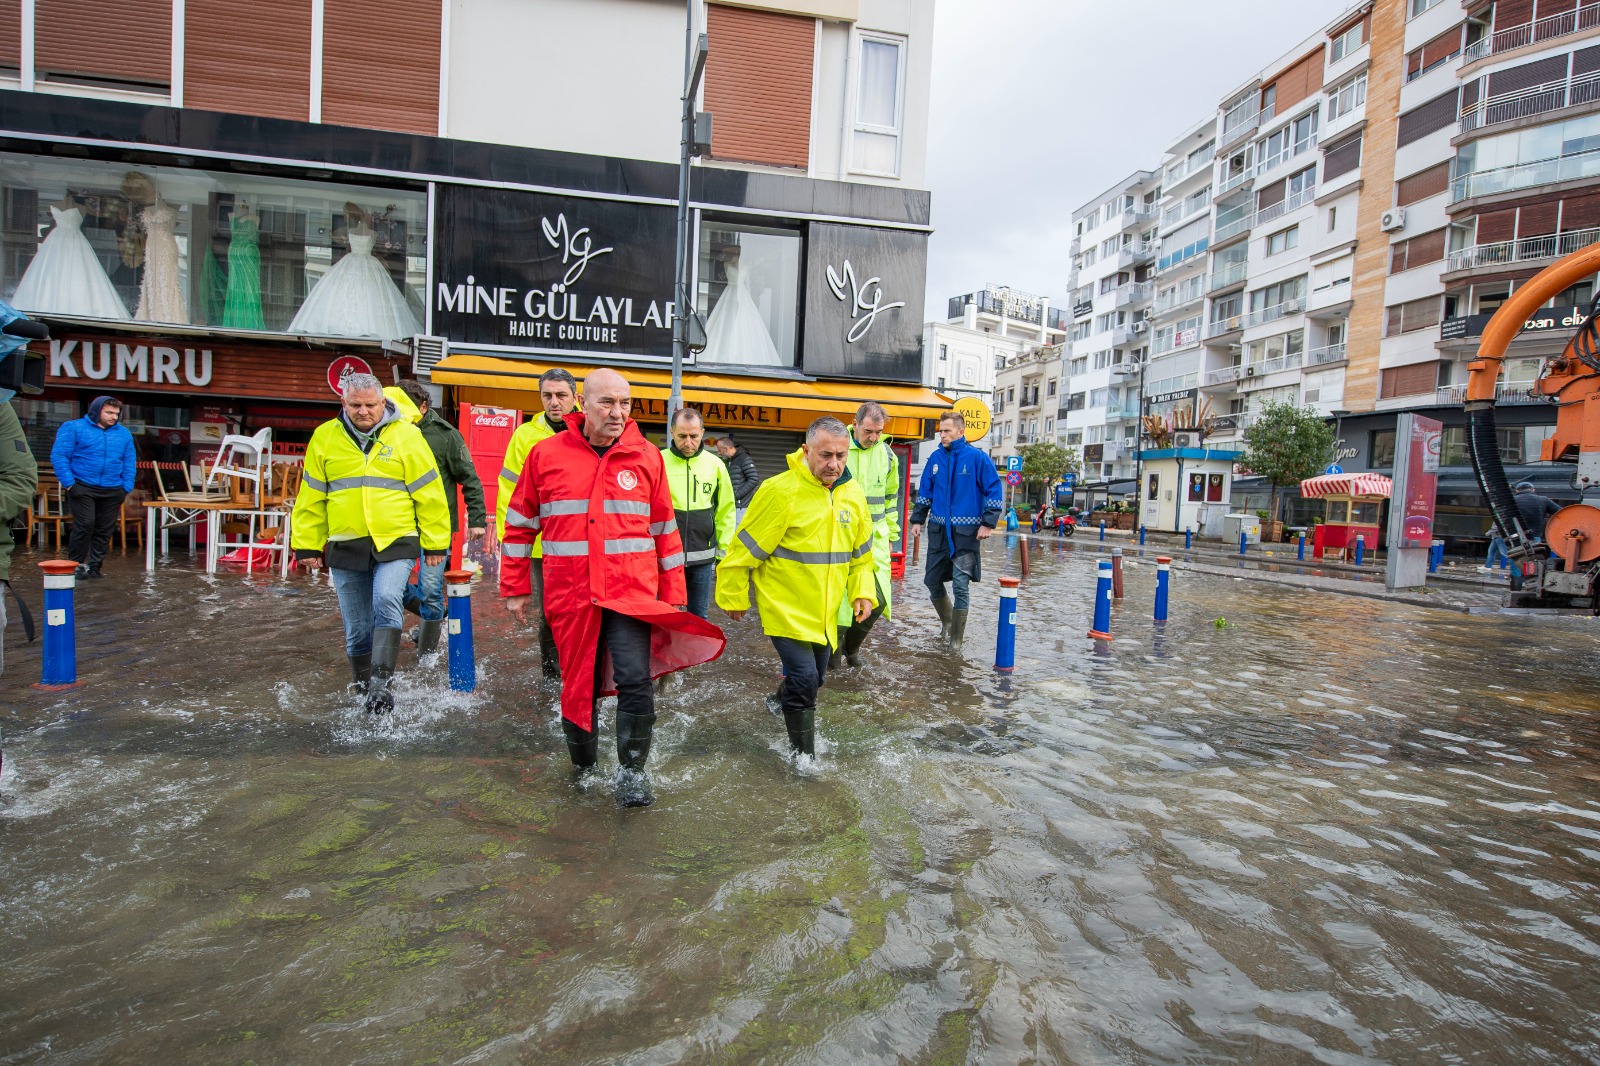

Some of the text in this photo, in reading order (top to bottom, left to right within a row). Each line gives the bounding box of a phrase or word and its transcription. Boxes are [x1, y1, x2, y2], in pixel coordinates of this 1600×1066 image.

[509, 320, 618, 344] HAUTE COUTURE
[50, 339, 213, 387] KUMRU
[475, 414, 510, 427] Coca-Cola
[959, 409, 982, 419] KALE
[965, 420, 988, 430] RKET
[1009, 457, 1019, 470] P
